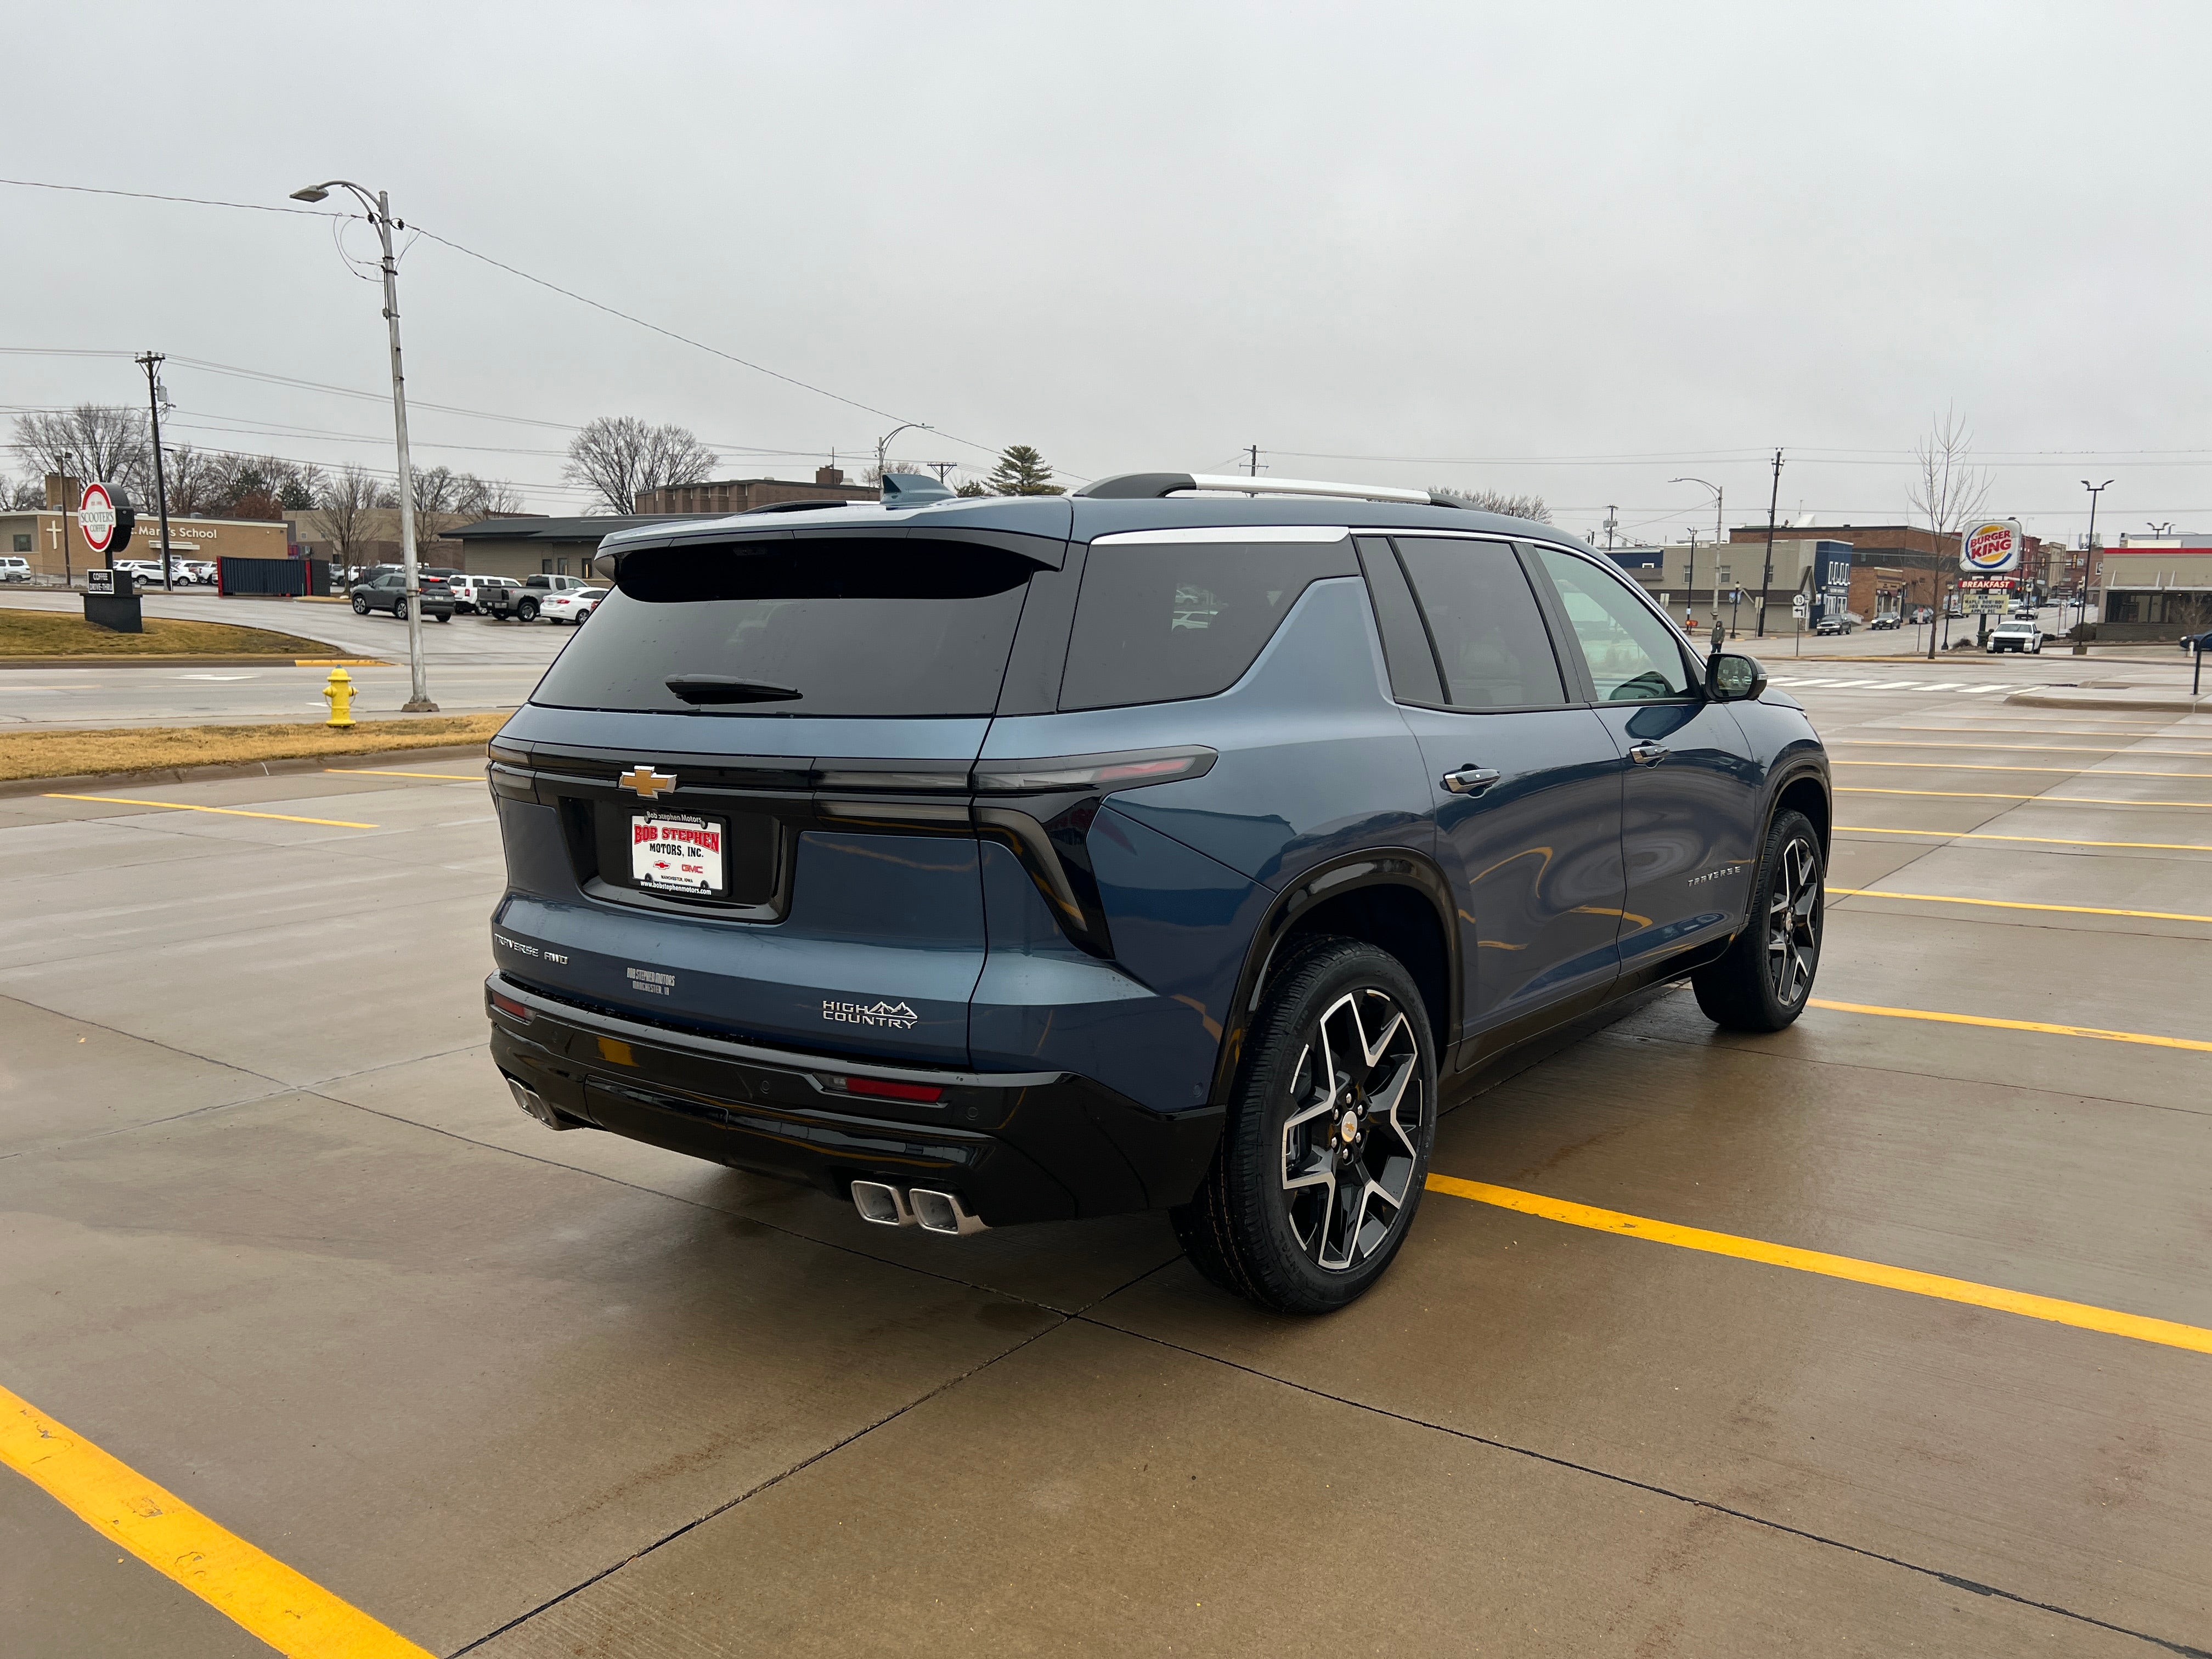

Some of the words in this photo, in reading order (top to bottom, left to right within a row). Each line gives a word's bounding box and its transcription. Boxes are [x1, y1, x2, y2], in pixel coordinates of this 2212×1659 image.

[89, 524, 106, 532] COFFEE
[139, 526, 176, 537] Mar's
[179, 527, 217, 539] School
[1971, 530, 2011, 548] BURGER
[1971, 539, 2012, 560] KING
[658, 812, 681, 821] Stephen
[681, 814, 702, 822] Motors
[634, 824, 658, 845] BOB
[662, 827, 719, 854] STEPHEN
[649, 843, 685, 858] MOTORS,
[687, 846, 703, 858] INC.
[681, 864, 703, 873] GMC
[1687, 866, 1741, 887] TRAVERSE
[640, 881, 712, 895] www.bobstephenmotors.com
[494, 933, 539, 957] TRAVERSE
[544, 951, 568, 964] AWD
[655, 973, 675, 986] MOTORS
[823, 1000, 868, 1014] HIGH
[823, 1011, 918, 1030] COUNTRY
